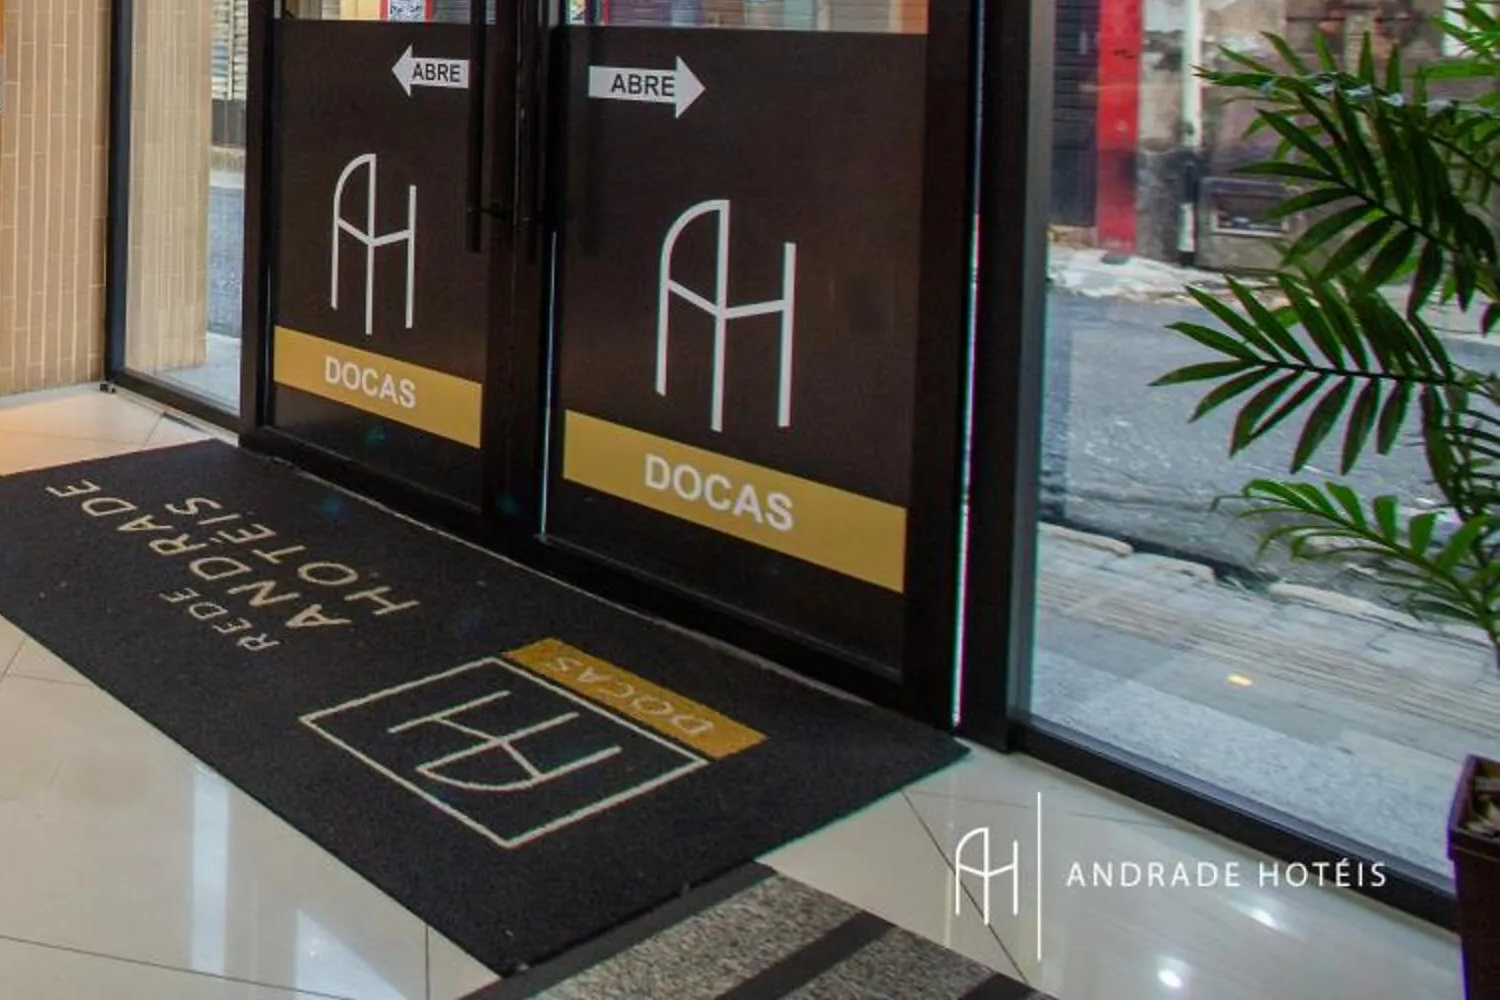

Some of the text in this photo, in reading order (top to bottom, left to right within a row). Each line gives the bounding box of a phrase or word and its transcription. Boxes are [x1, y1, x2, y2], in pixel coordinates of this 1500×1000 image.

[411, 61, 462, 83] ABRE
[610, 73, 676, 97] ABRE
[324, 355, 417, 410] DOCAS
[644, 452, 796, 532] DOCAS
[46, 478, 353, 629] ANDRADE
[158, 586, 281, 652] REDE
[545, 655, 716, 737] DOCAS
